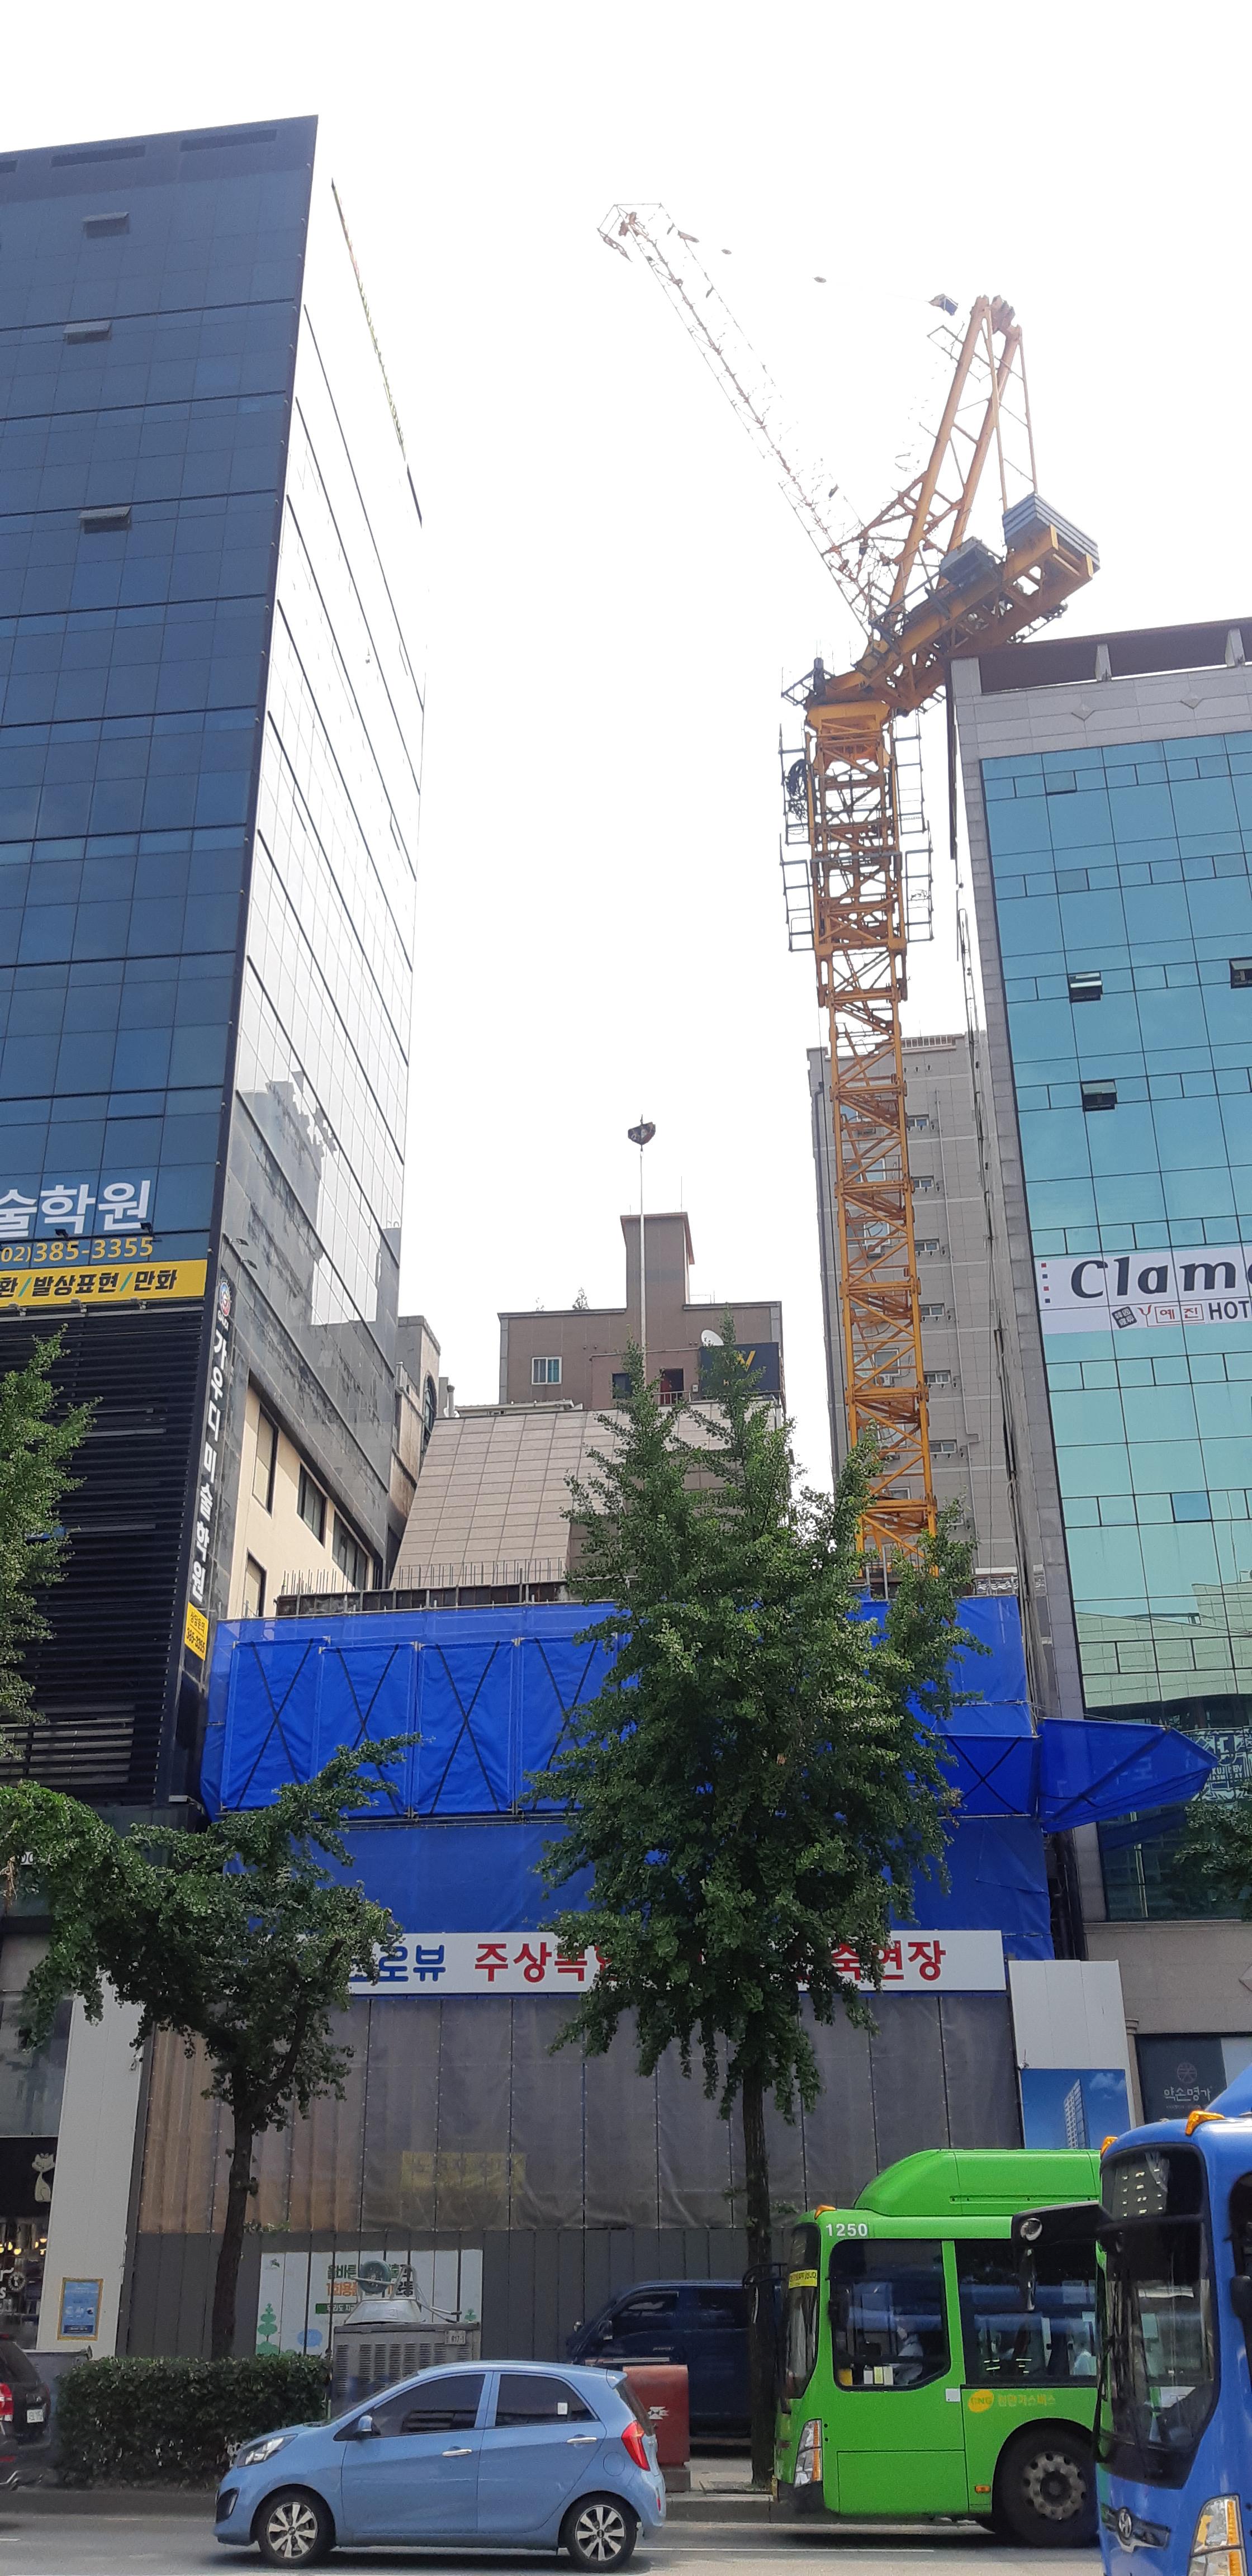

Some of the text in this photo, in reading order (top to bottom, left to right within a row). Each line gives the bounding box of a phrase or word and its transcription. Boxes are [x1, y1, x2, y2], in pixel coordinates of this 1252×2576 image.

[0, 1180, 151, 1238] 술학원
[1071, 1256, 1252, 1299] Clam
[1159, 1308, 1198, 1320] 예진
[187, 1627, 205, 1654] 385-3355
[1164, 2086, 1211, 2101] 약손명가
[826, 2223, 867, 2237] 1250
